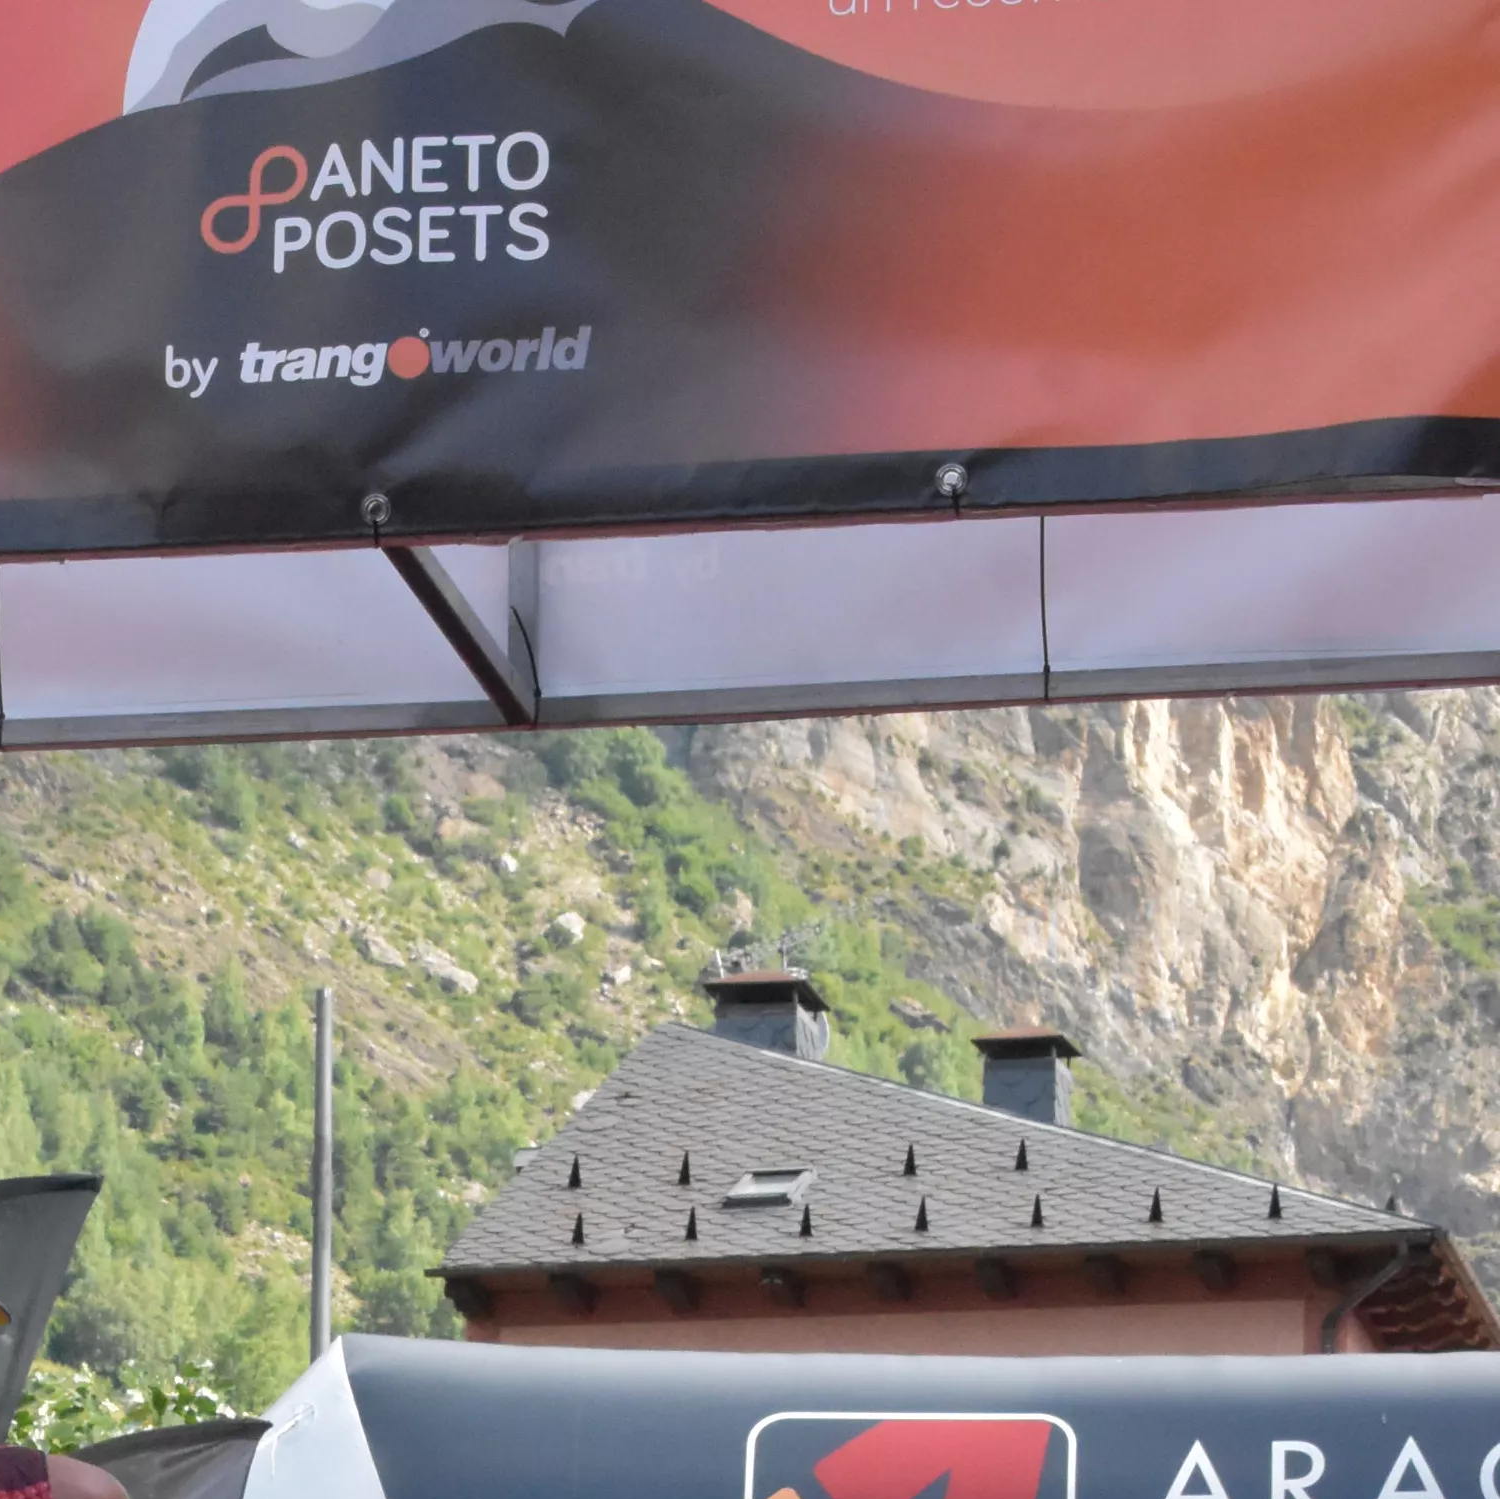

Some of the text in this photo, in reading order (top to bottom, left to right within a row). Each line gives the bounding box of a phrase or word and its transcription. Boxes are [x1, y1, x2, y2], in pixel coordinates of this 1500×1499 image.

[309, 131, 551, 202] ANETO
[273, 202, 551, 274] POSETS
[163, 345, 219, 399] by
